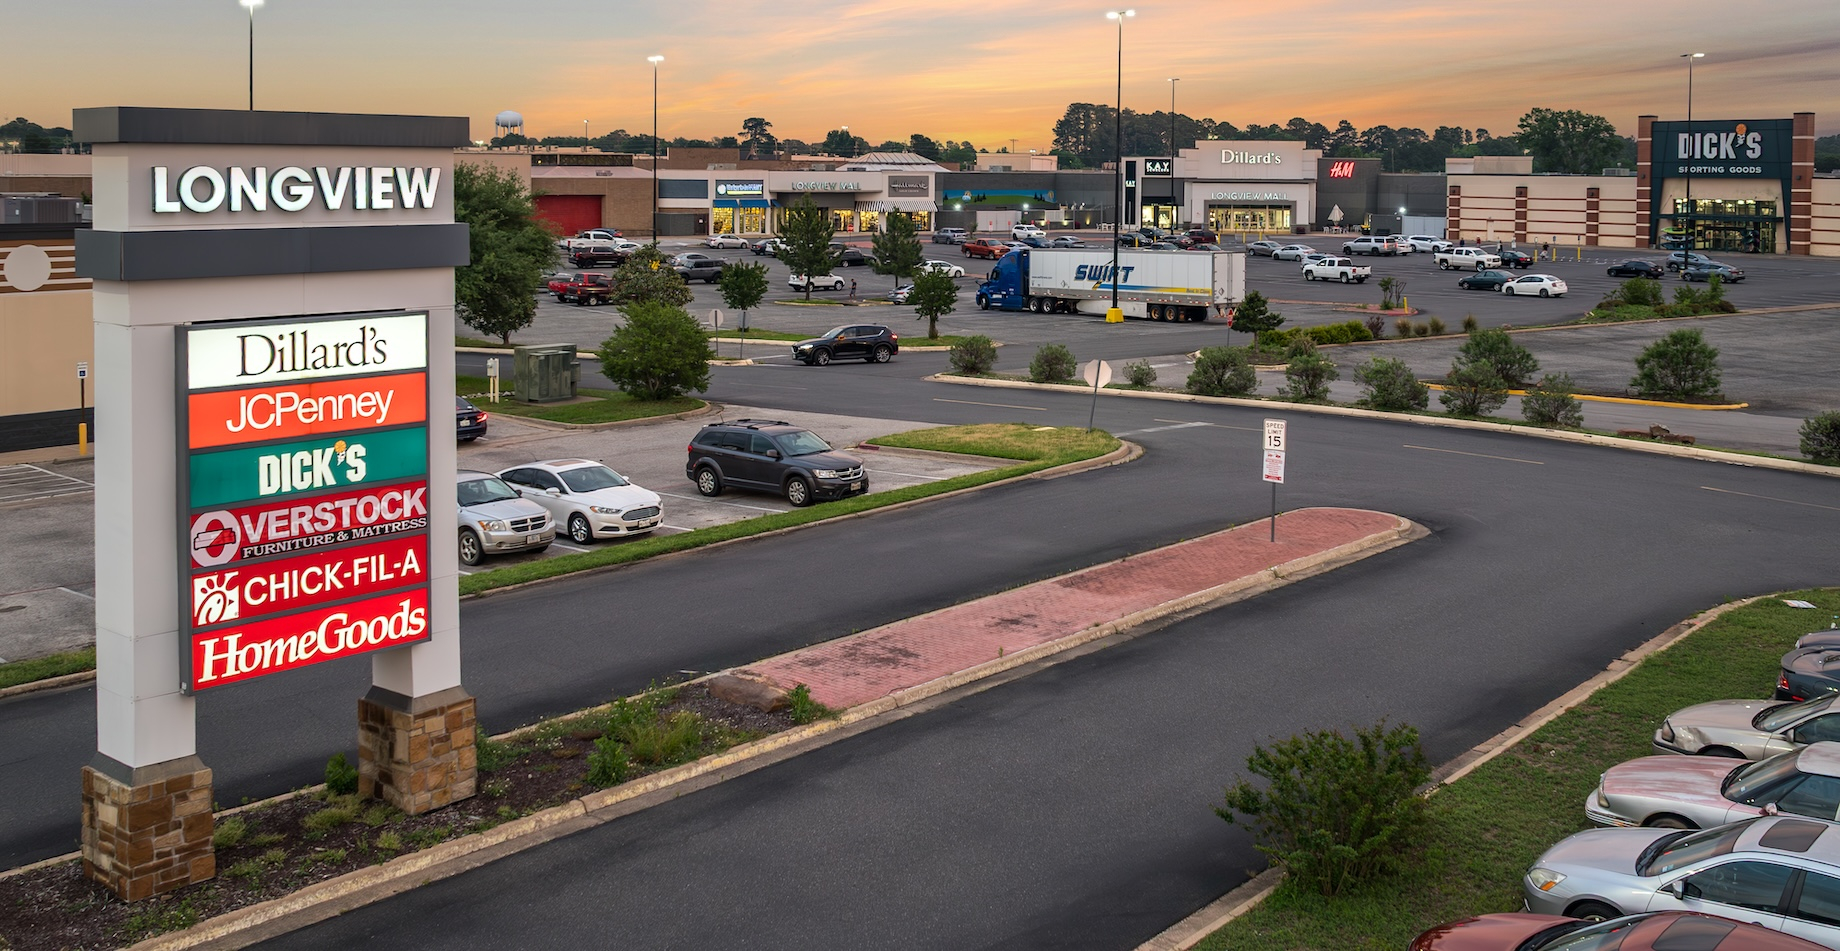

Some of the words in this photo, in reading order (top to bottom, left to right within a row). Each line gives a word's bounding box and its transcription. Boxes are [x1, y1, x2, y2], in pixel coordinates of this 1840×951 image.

[1678, 129, 1762, 159] DICK'S
[1221, 149, 1282, 165] Dillard's
[1330, 161, 1355, 178] H&M
[1729, 166, 1762, 174] GOODS
[151, 165, 442, 213] LONGVIEW
[791, 181, 838, 191] LONGVIEW
[839, 181, 862, 191] MALL
[1211, 192, 1261, 201] LONGVIEW
[1263, 192, 1289, 201] MALL
[1074, 264, 1135, 283] SWIFT
[236, 325, 388, 378] Dillard's
[226, 389, 395, 433] JCPenney
[1266, 422, 1285, 430] SPEED
[1268, 435, 1281, 447] 15
[258, 441, 367, 496] DICK'S
[242, 532, 335, 559] FURNITURE
[337, 531, 349, 542] &
[352, 517, 428, 540] MATTRESS
[244, 549, 421, 606] CHICK-FIL-A
[197, 598, 426, 684] HomeGoods
